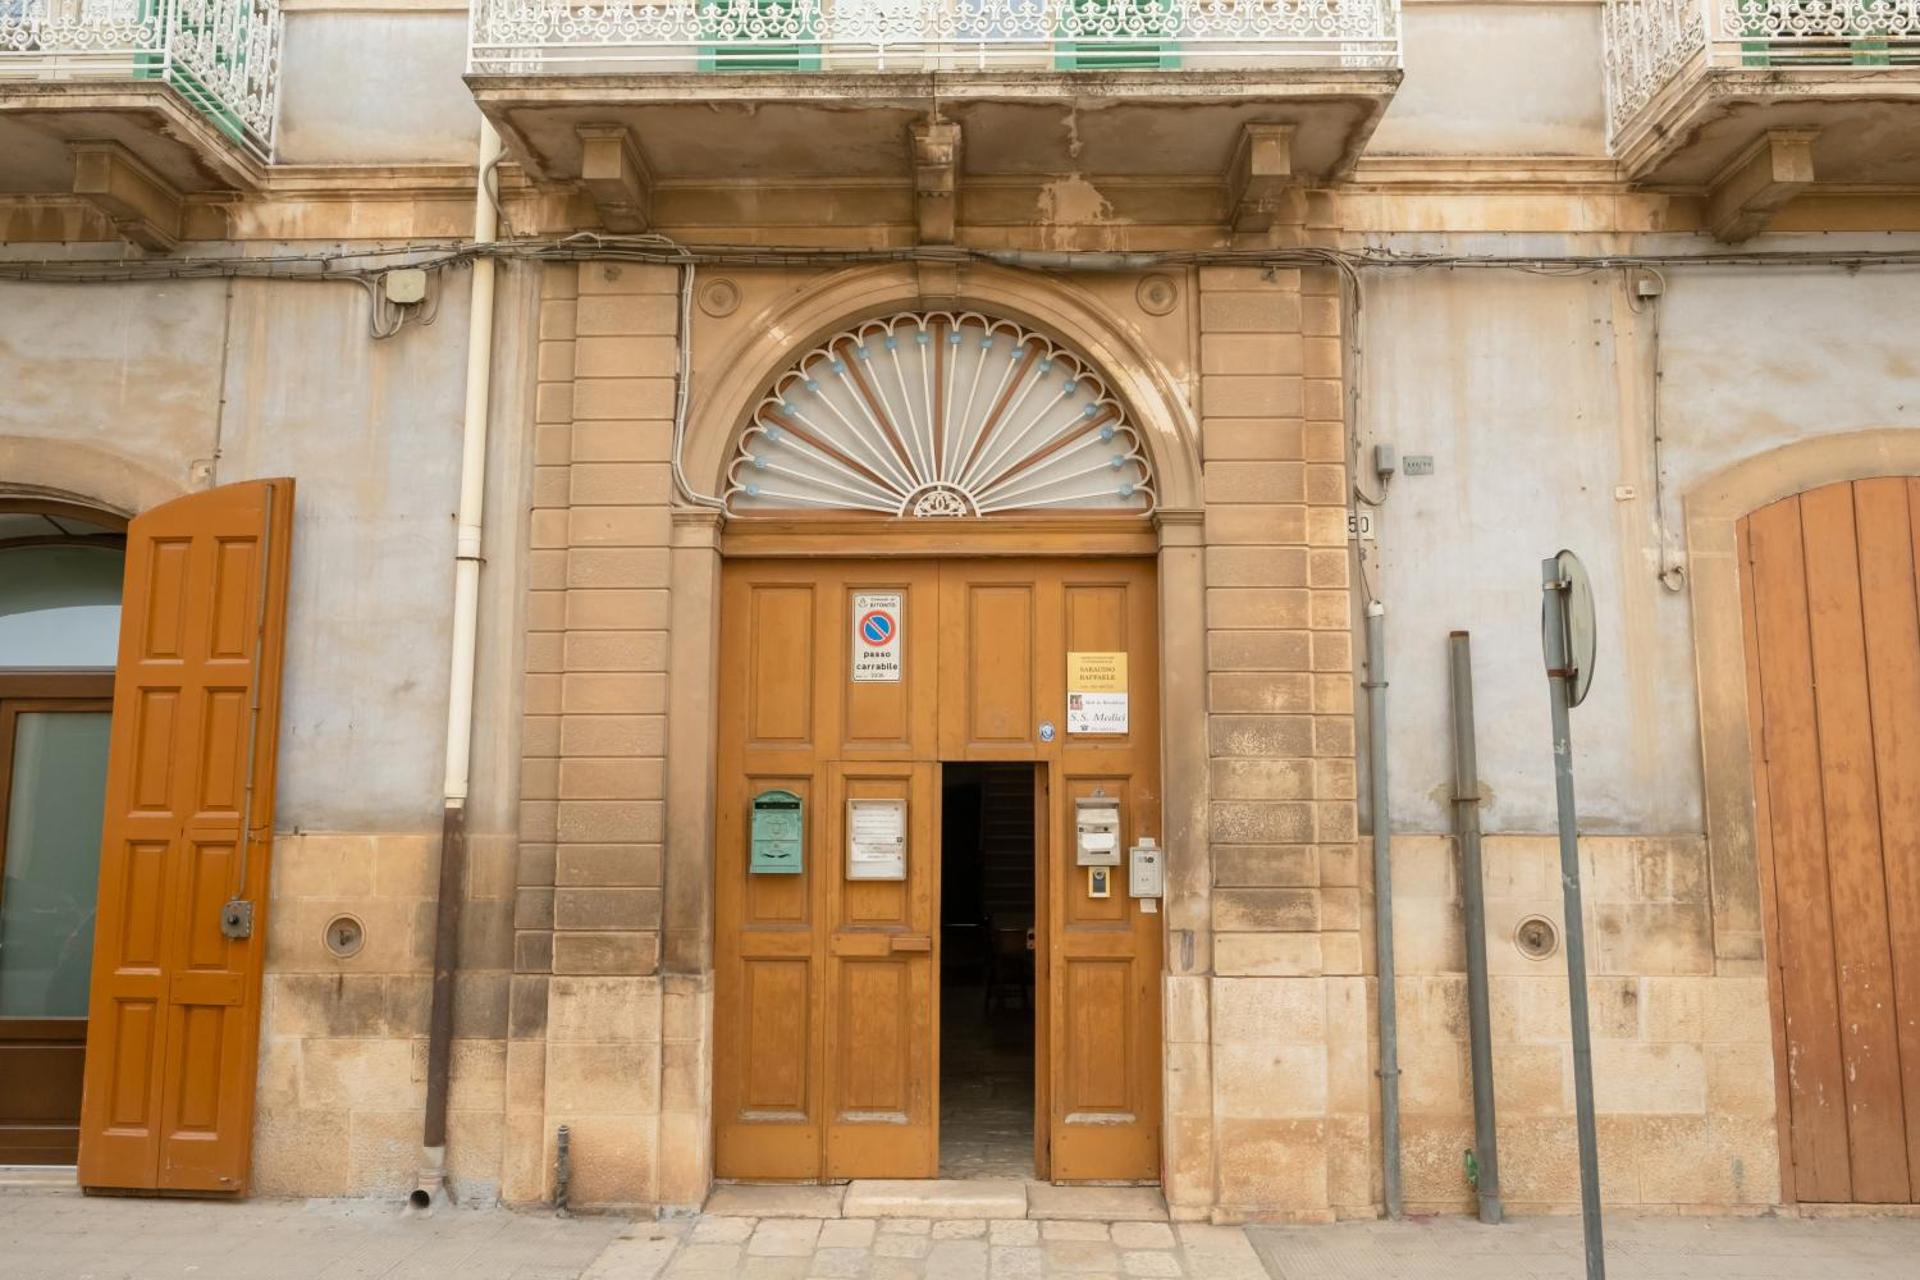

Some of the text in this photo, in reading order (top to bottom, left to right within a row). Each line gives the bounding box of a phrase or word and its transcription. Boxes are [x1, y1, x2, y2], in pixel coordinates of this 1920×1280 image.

[1348, 515, 1369, 533] 50
[864, 651, 891, 659] passo
[856, 662, 898, 671] carrabile
[1095, 713, 1126, 721] Medici
